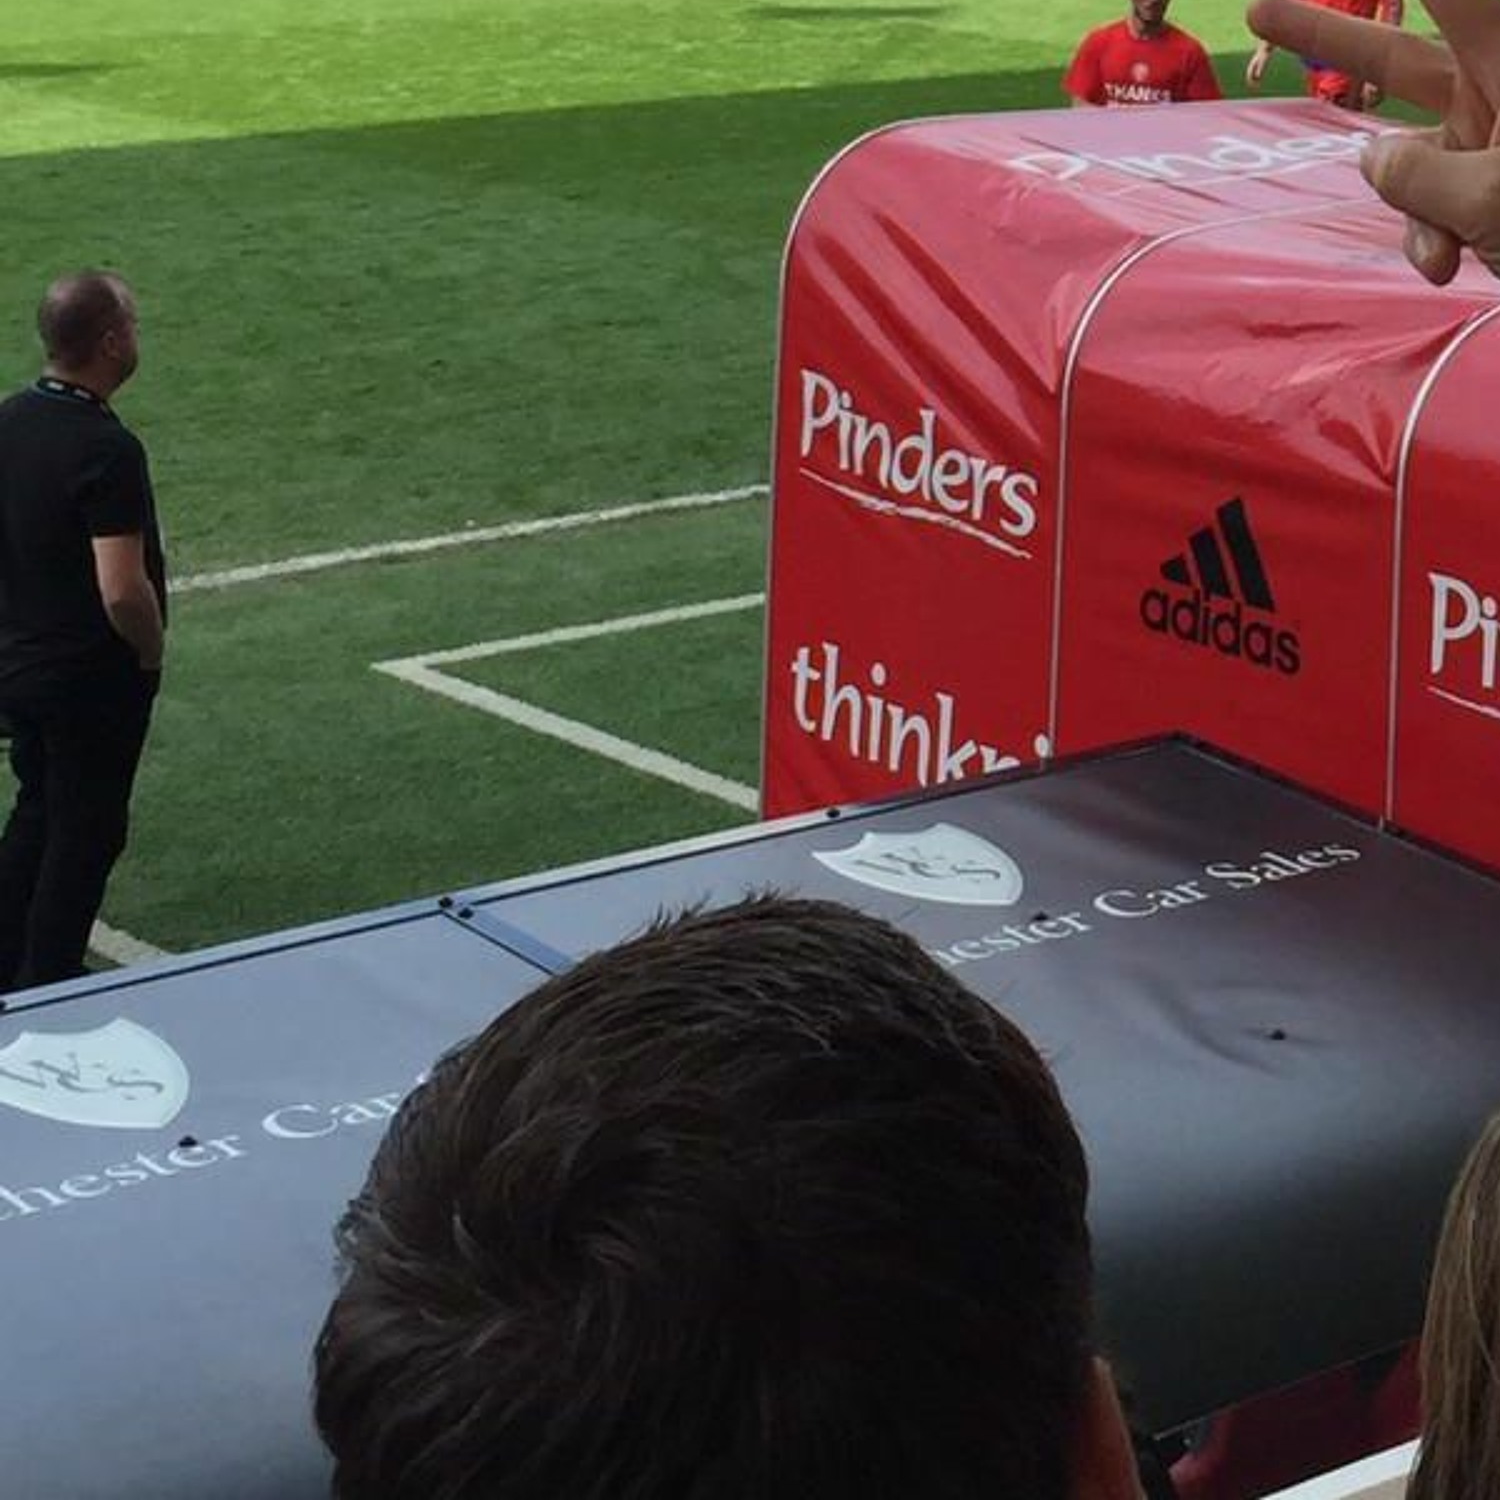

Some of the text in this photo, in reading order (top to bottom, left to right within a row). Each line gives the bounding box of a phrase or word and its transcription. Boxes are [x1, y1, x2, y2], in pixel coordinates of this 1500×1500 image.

[800, 368, 1039, 537] Pinders
[1140, 587, 1301, 676] adidas
[1094, 878, 1210, 920] Car
[1205, 841, 1361, 890] Sales
[262, 1092, 402, 1139] Car
